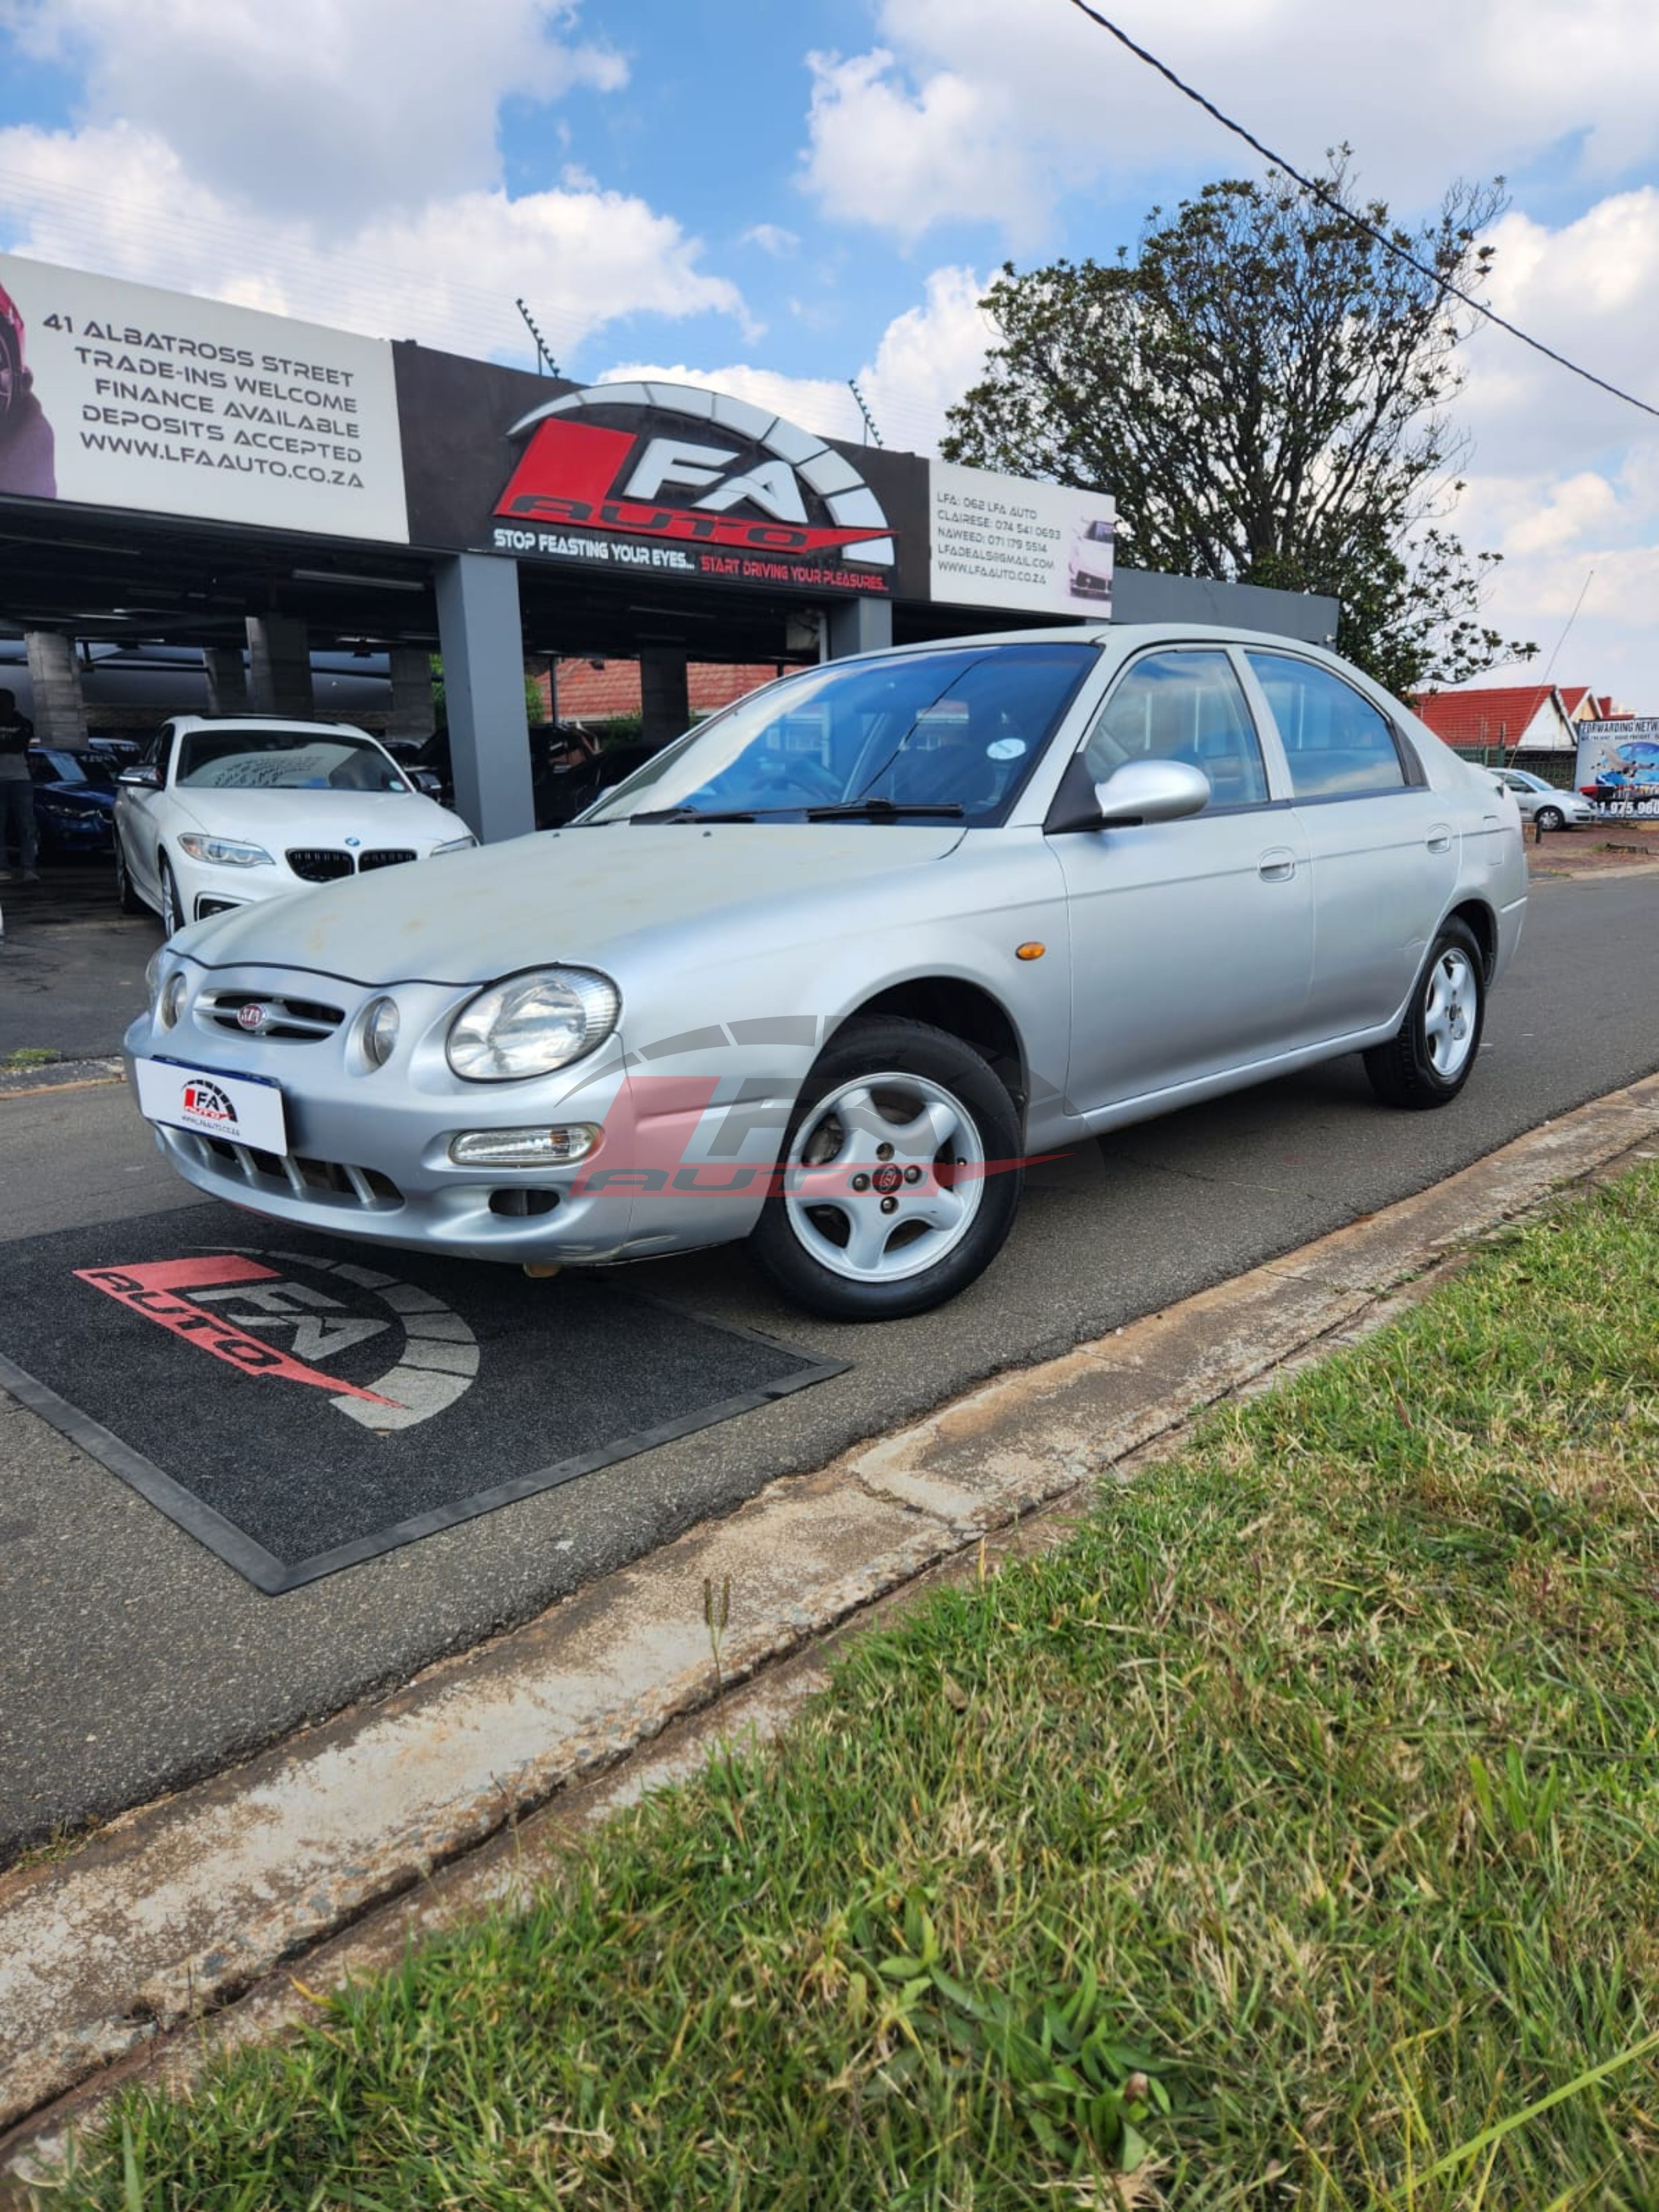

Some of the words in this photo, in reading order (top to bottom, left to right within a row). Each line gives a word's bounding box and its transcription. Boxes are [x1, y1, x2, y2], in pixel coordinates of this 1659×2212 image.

[43, 314, 72, 333] 41
[84, 321, 254, 367] ALBATROSS
[262, 356, 354, 387] STREET
[75, 347, 227, 388] TRADE-INS
[235, 377, 356, 412] WELCOME
[83, 405, 223, 441] DEPOSITS
[235, 431, 361, 462] ACCEPTED
[96, 379, 213, 413] FINANCE
[224, 402, 358, 438] AVAILABLE
[81, 433, 364, 488] WWW.LFAAUTO.CO.ZA
[510, 495, 808, 547] AUTO
[988, 502, 1006, 515] LFA
[1009, 507, 1037, 520] AUTO
[494, 529, 535, 549] STOP
[539, 535, 608, 559] FEASTING
[611, 544, 650, 564] YOUR
[701, 555, 739, 573] START
[744, 561, 789, 579] DRIVING
[792, 567, 822, 582] YOUR
[88, 1272, 284, 1367] AUTO
